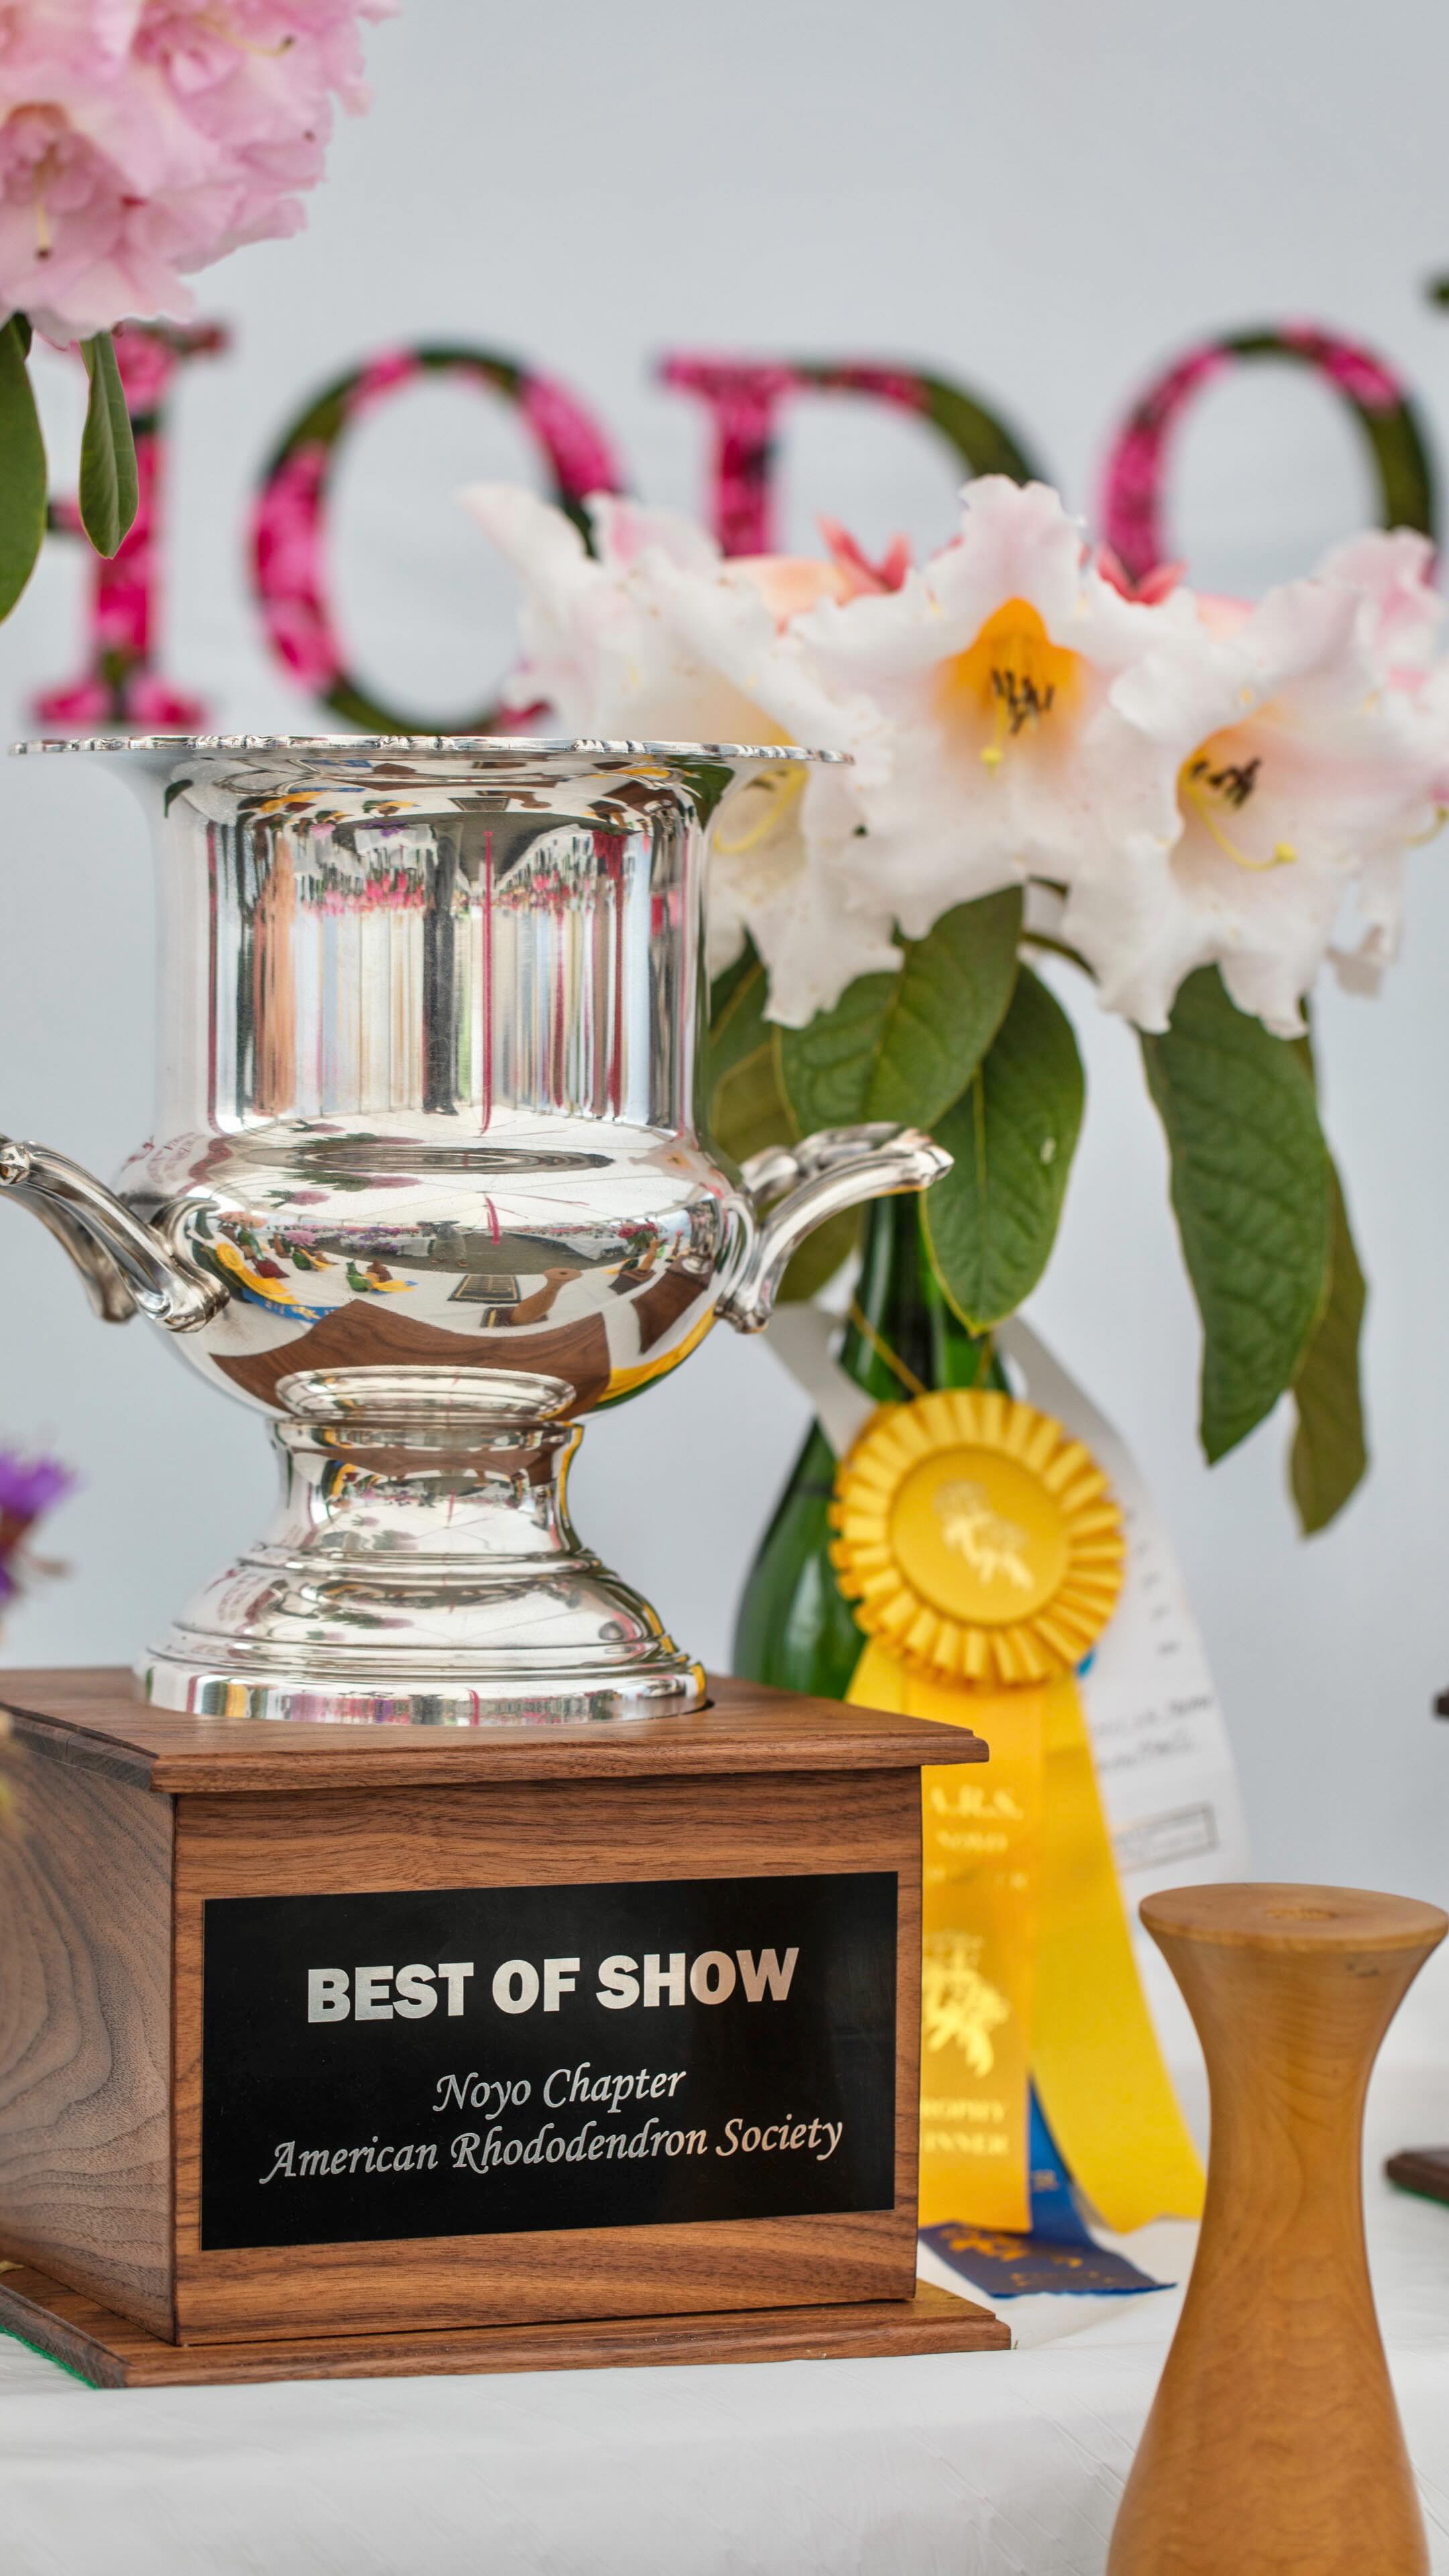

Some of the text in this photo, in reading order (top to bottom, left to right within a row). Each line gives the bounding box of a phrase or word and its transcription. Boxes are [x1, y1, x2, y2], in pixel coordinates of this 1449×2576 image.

[307, 1947, 800, 2023] BEST OF SHOW
[432, 2061, 687, 2121] Noyo Chapter
[258, 2113, 843, 2184] American Rhododendron Society
